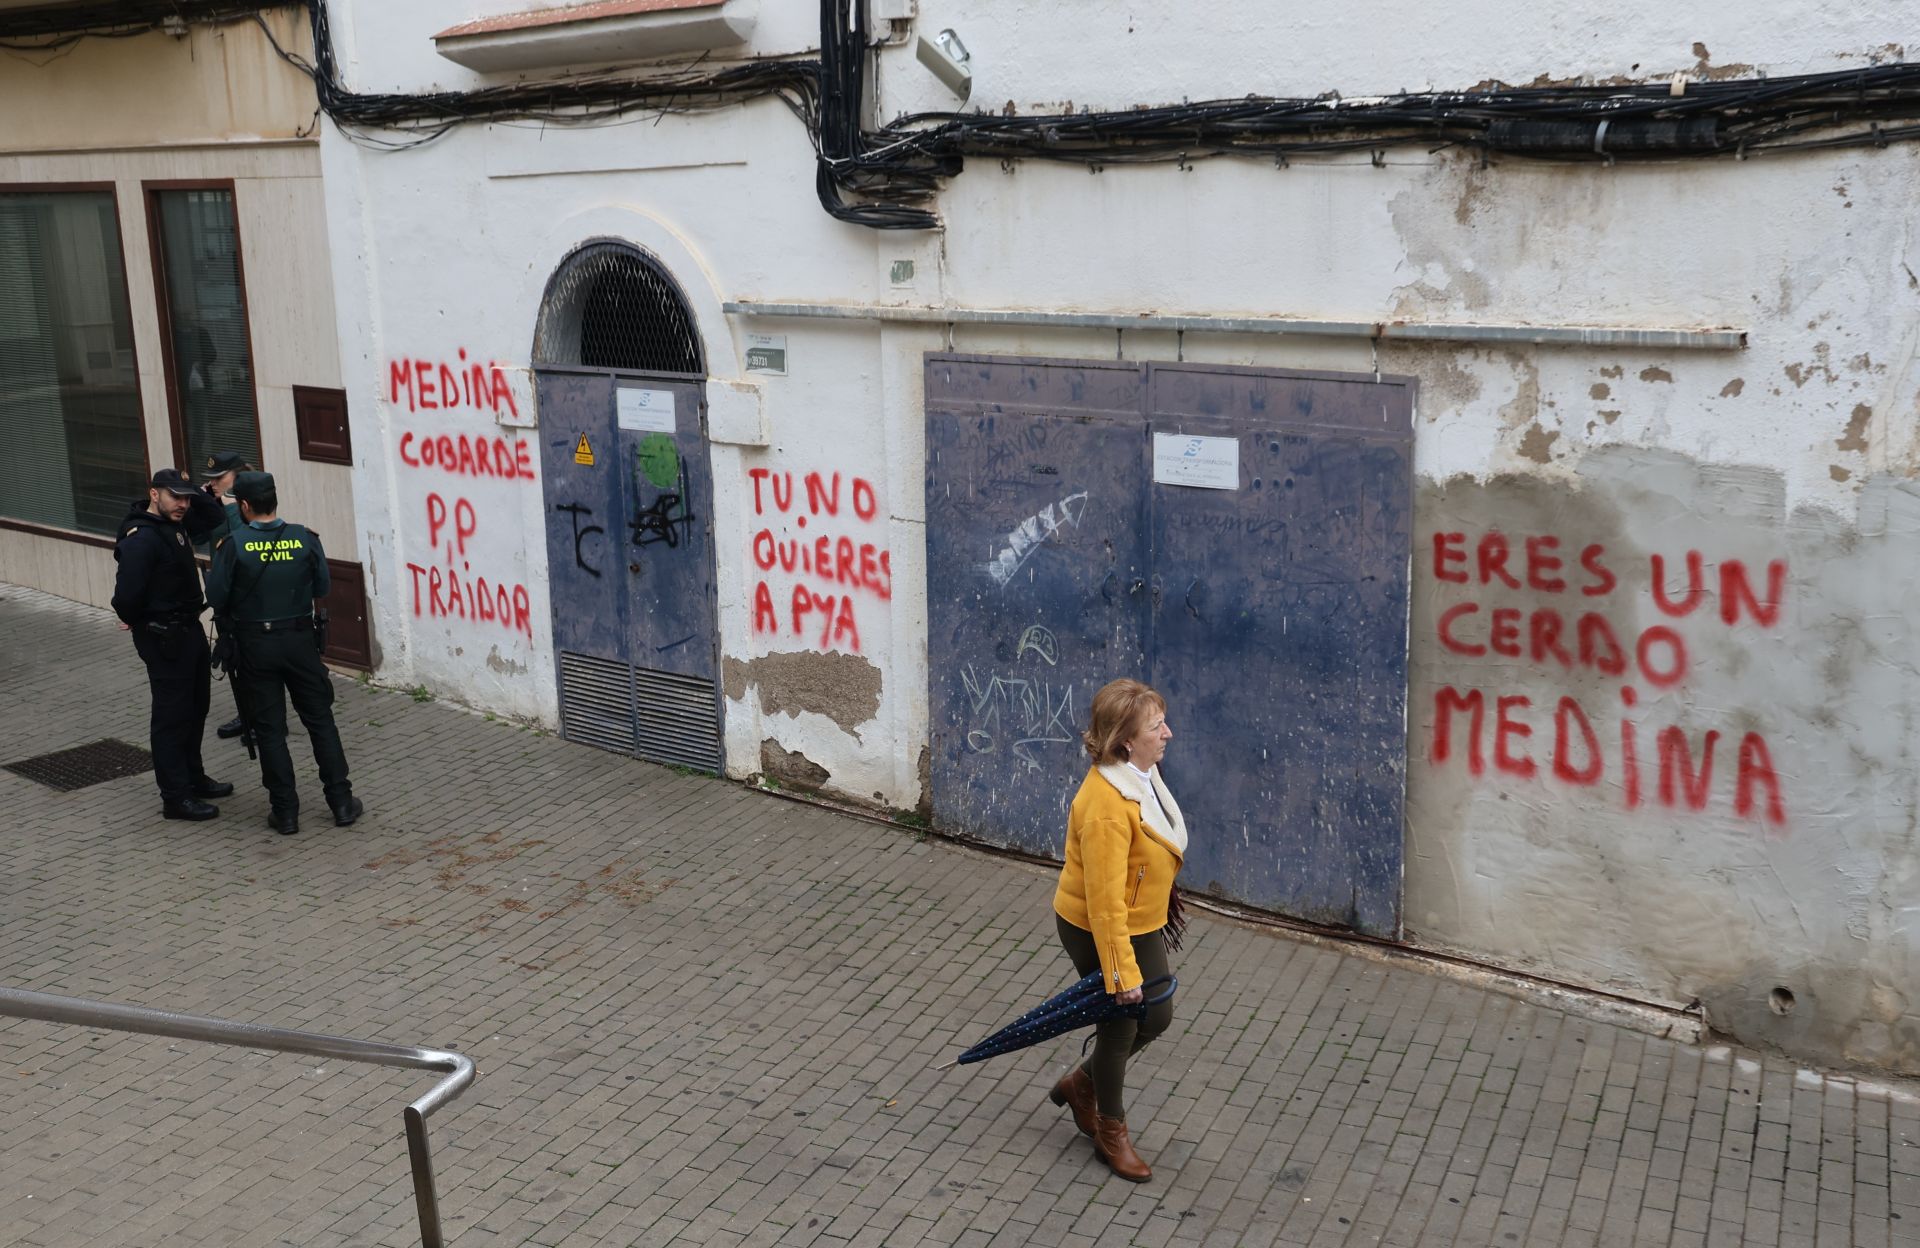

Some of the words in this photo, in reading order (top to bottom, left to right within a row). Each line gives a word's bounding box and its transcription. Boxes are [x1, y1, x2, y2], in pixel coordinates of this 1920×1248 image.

[399, 431, 536, 480] COBARDE
[748, 467, 793, 515] TU
[804, 470, 878, 523] NO
[755, 580, 777, 633] A
[1432, 530, 1617, 597] ERES
[1650, 549, 1787, 628] UN
[1436, 602, 1688, 688] CERDO
